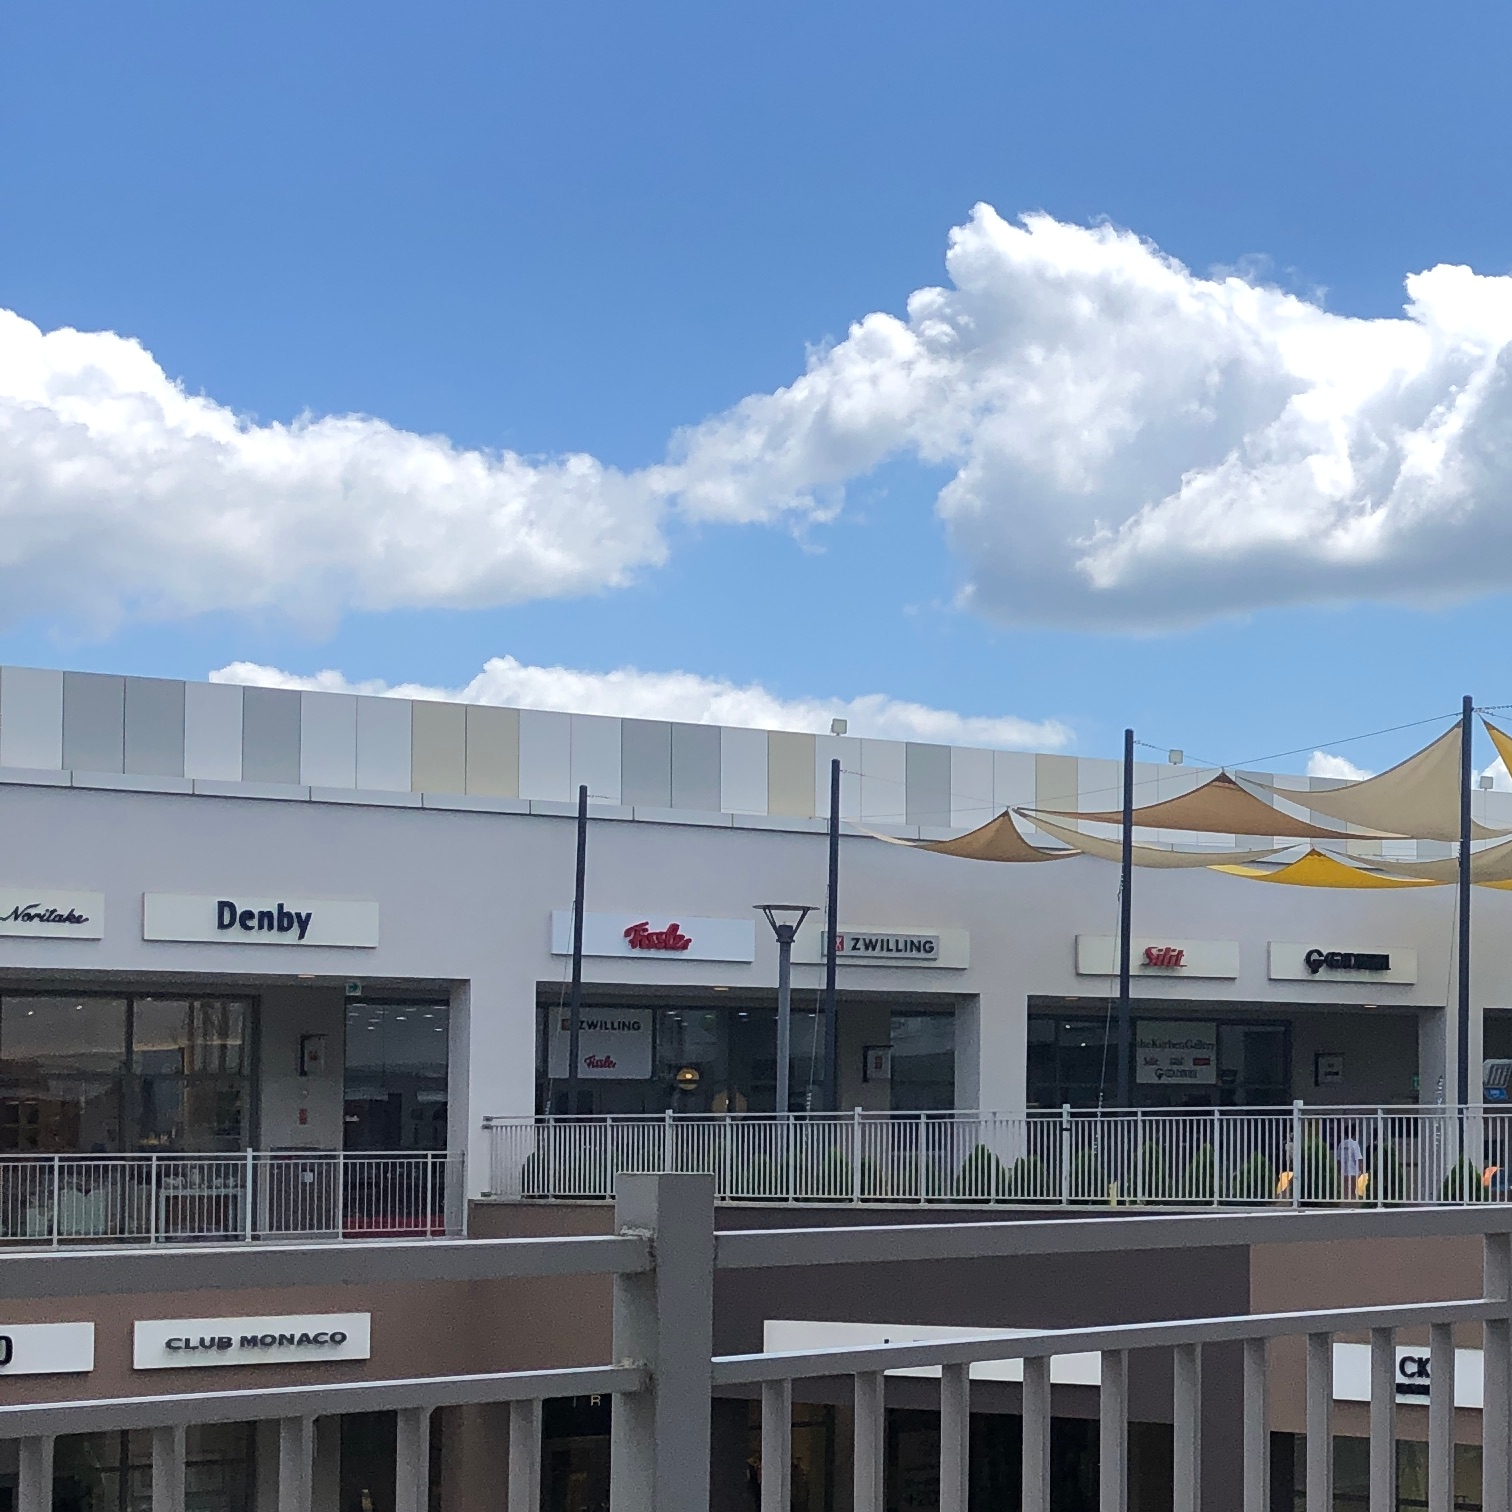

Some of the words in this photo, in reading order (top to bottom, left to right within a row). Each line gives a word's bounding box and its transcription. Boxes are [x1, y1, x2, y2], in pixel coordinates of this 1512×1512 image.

[0, 903, 89, 924] Noritake
[216, 900, 312, 941] Denby
[850, 937, 935, 954] ZWILLING
[579, 1020, 641, 1031] ZWILLING
[165, 1337, 234, 1351] CLUB
[239, 1331, 348, 1348] MONACO
